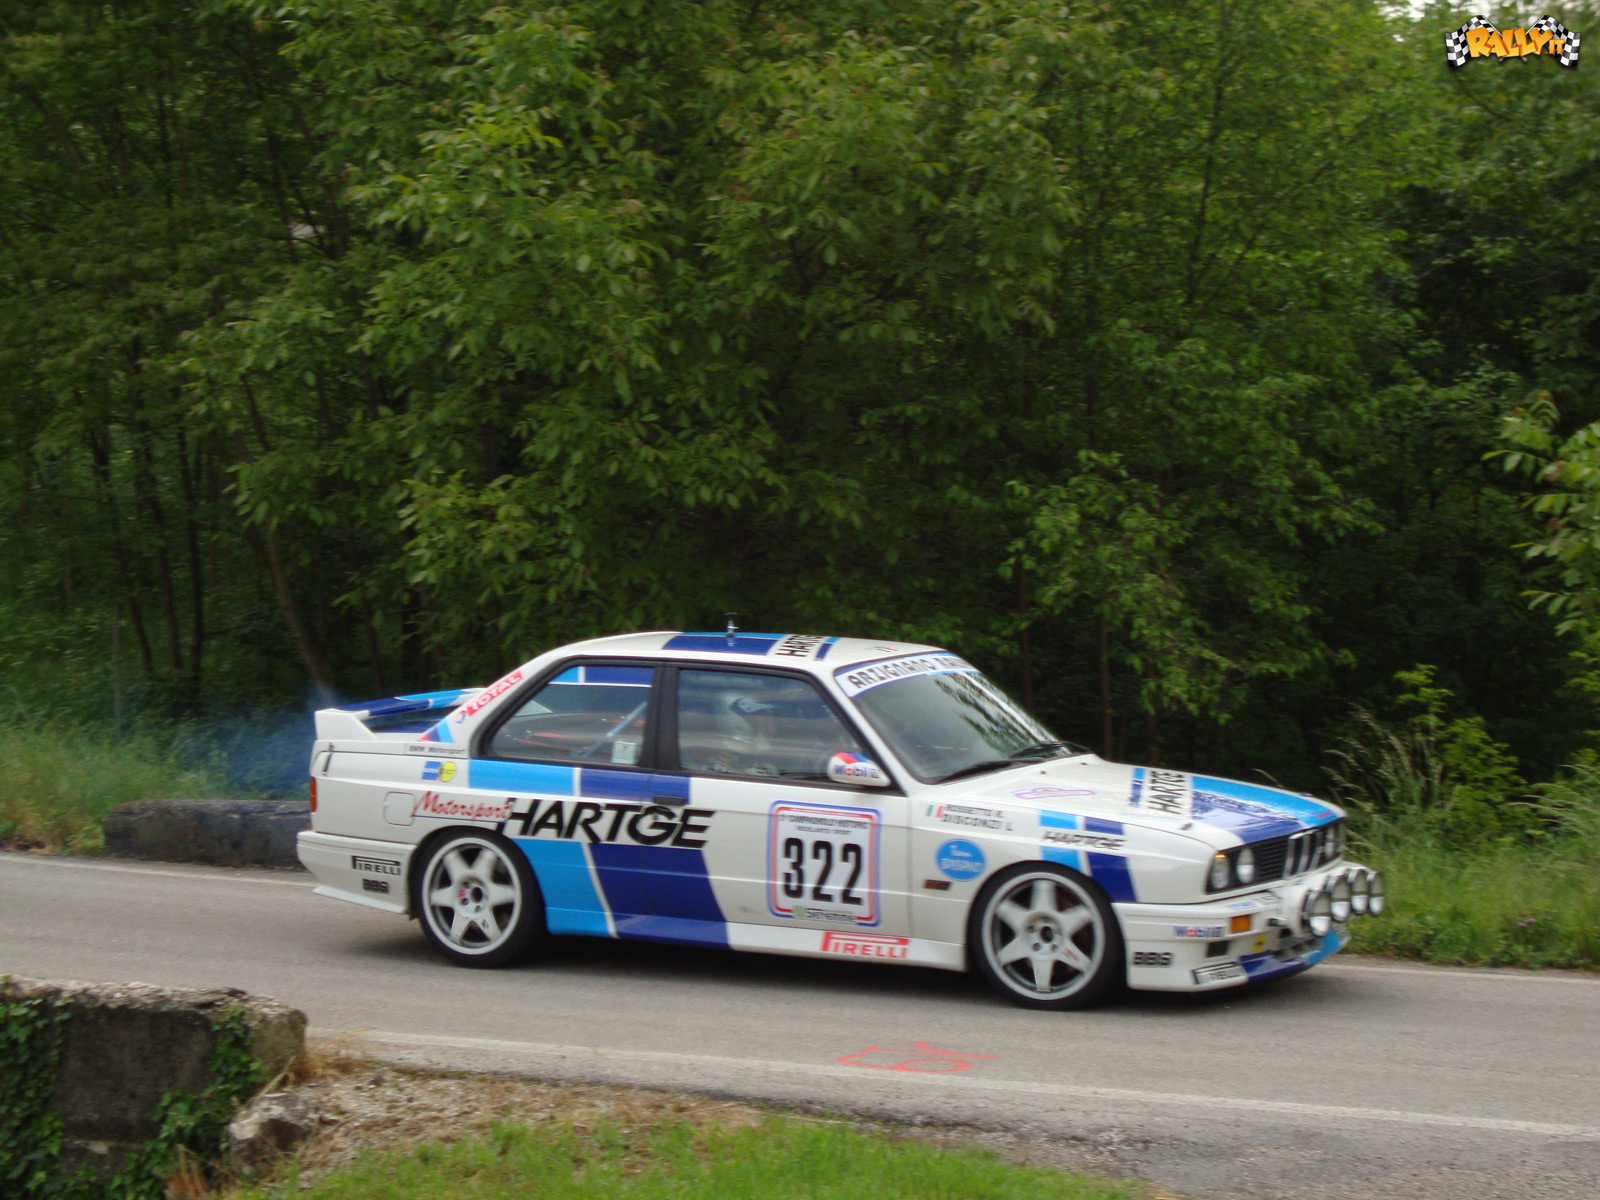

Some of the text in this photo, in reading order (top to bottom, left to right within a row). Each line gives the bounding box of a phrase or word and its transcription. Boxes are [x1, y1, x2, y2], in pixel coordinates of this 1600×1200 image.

[470, 672, 522, 713] TOTAL
[409, 790, 512, 821] Motorsport
[496, 797, 715, 849] HARTGE
[351, 855, 401, 875] PIRELLI
[783, 837, 863, 905] 322
[821, 931, 911, 958] PIRELLI
[1174, 926, 1212, 938] Mobil
[1132, 951, 1173, 967] BBS
